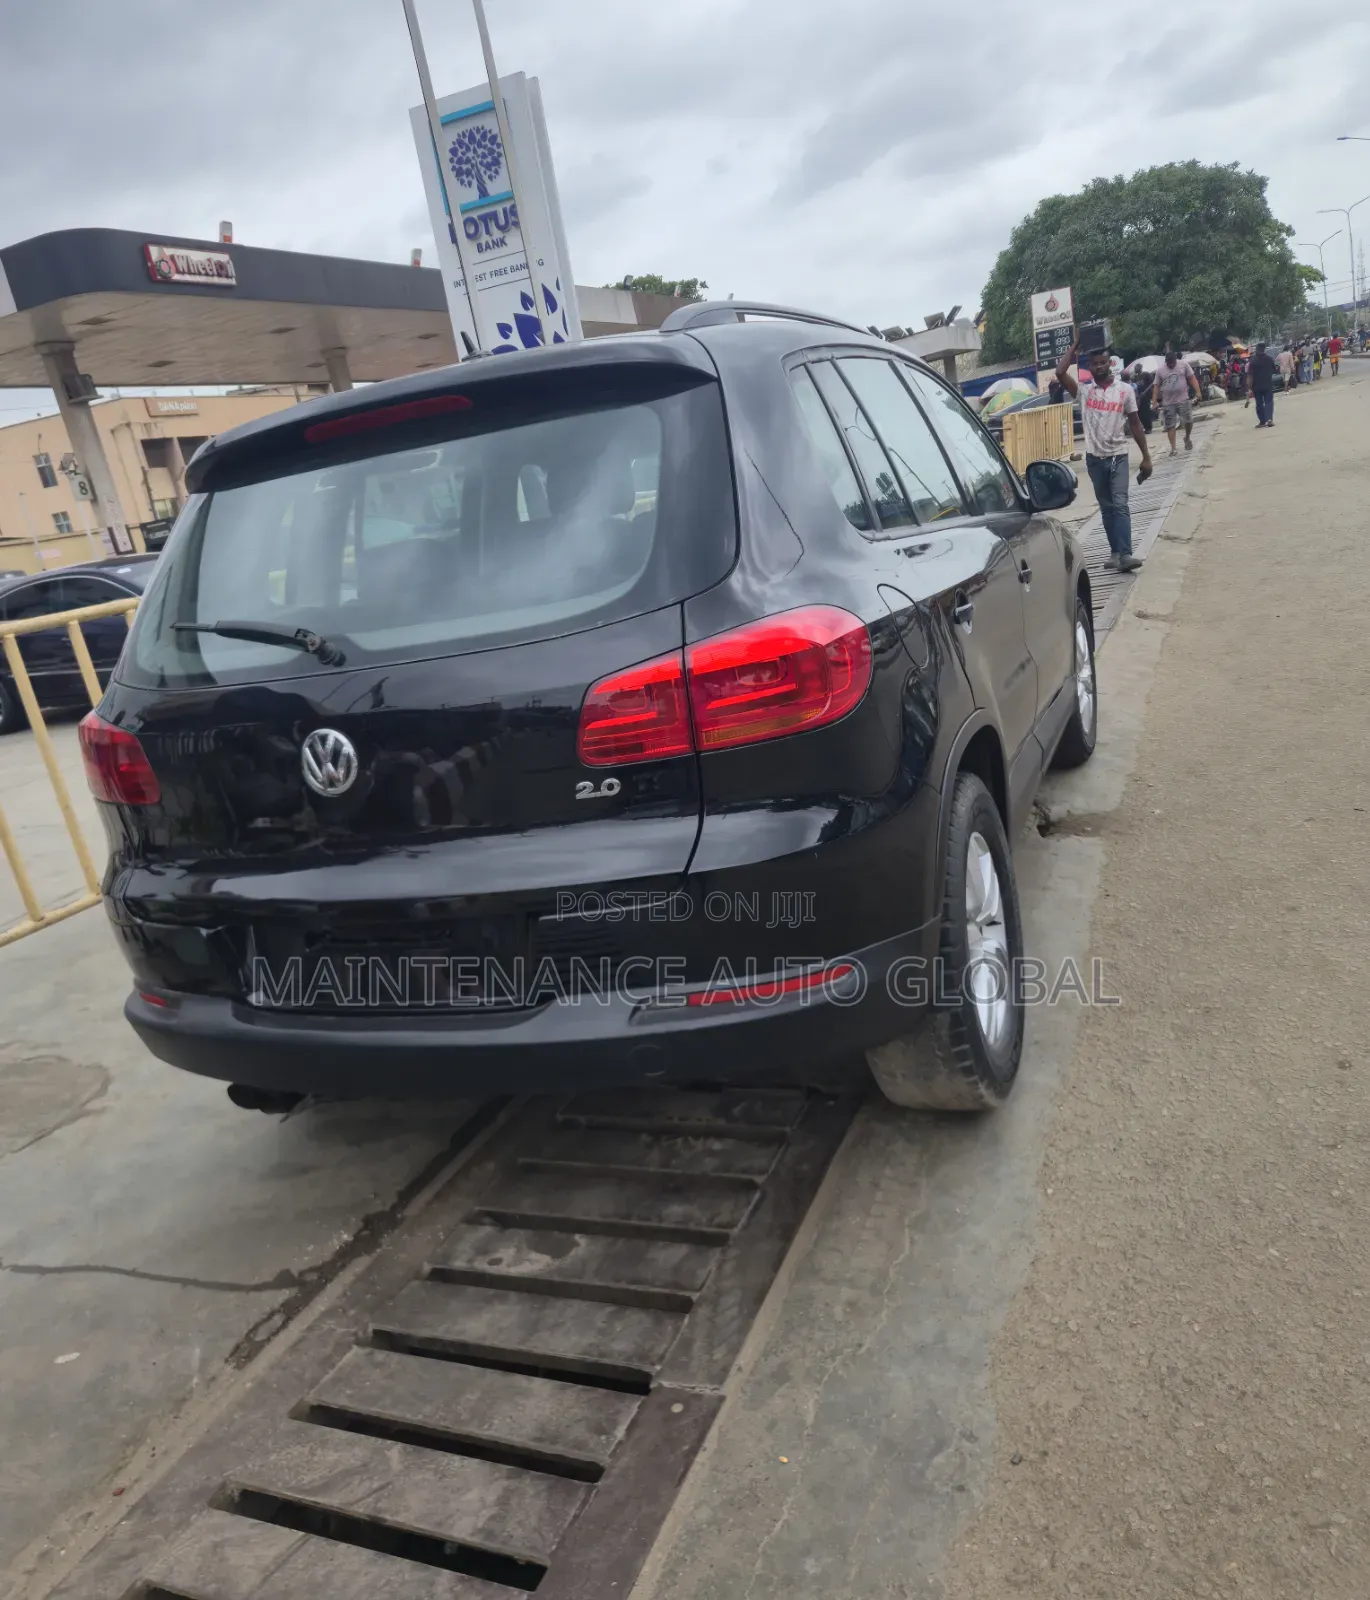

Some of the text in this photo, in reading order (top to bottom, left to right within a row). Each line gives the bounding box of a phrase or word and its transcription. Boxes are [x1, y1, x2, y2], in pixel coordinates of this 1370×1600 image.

[476, 236, 508, 254] BANK
[453, 258, 545, 288] INTEST FREE BANG
[78, 481, 89, 496] 8
[576, 777, 621, 800] 2.0
